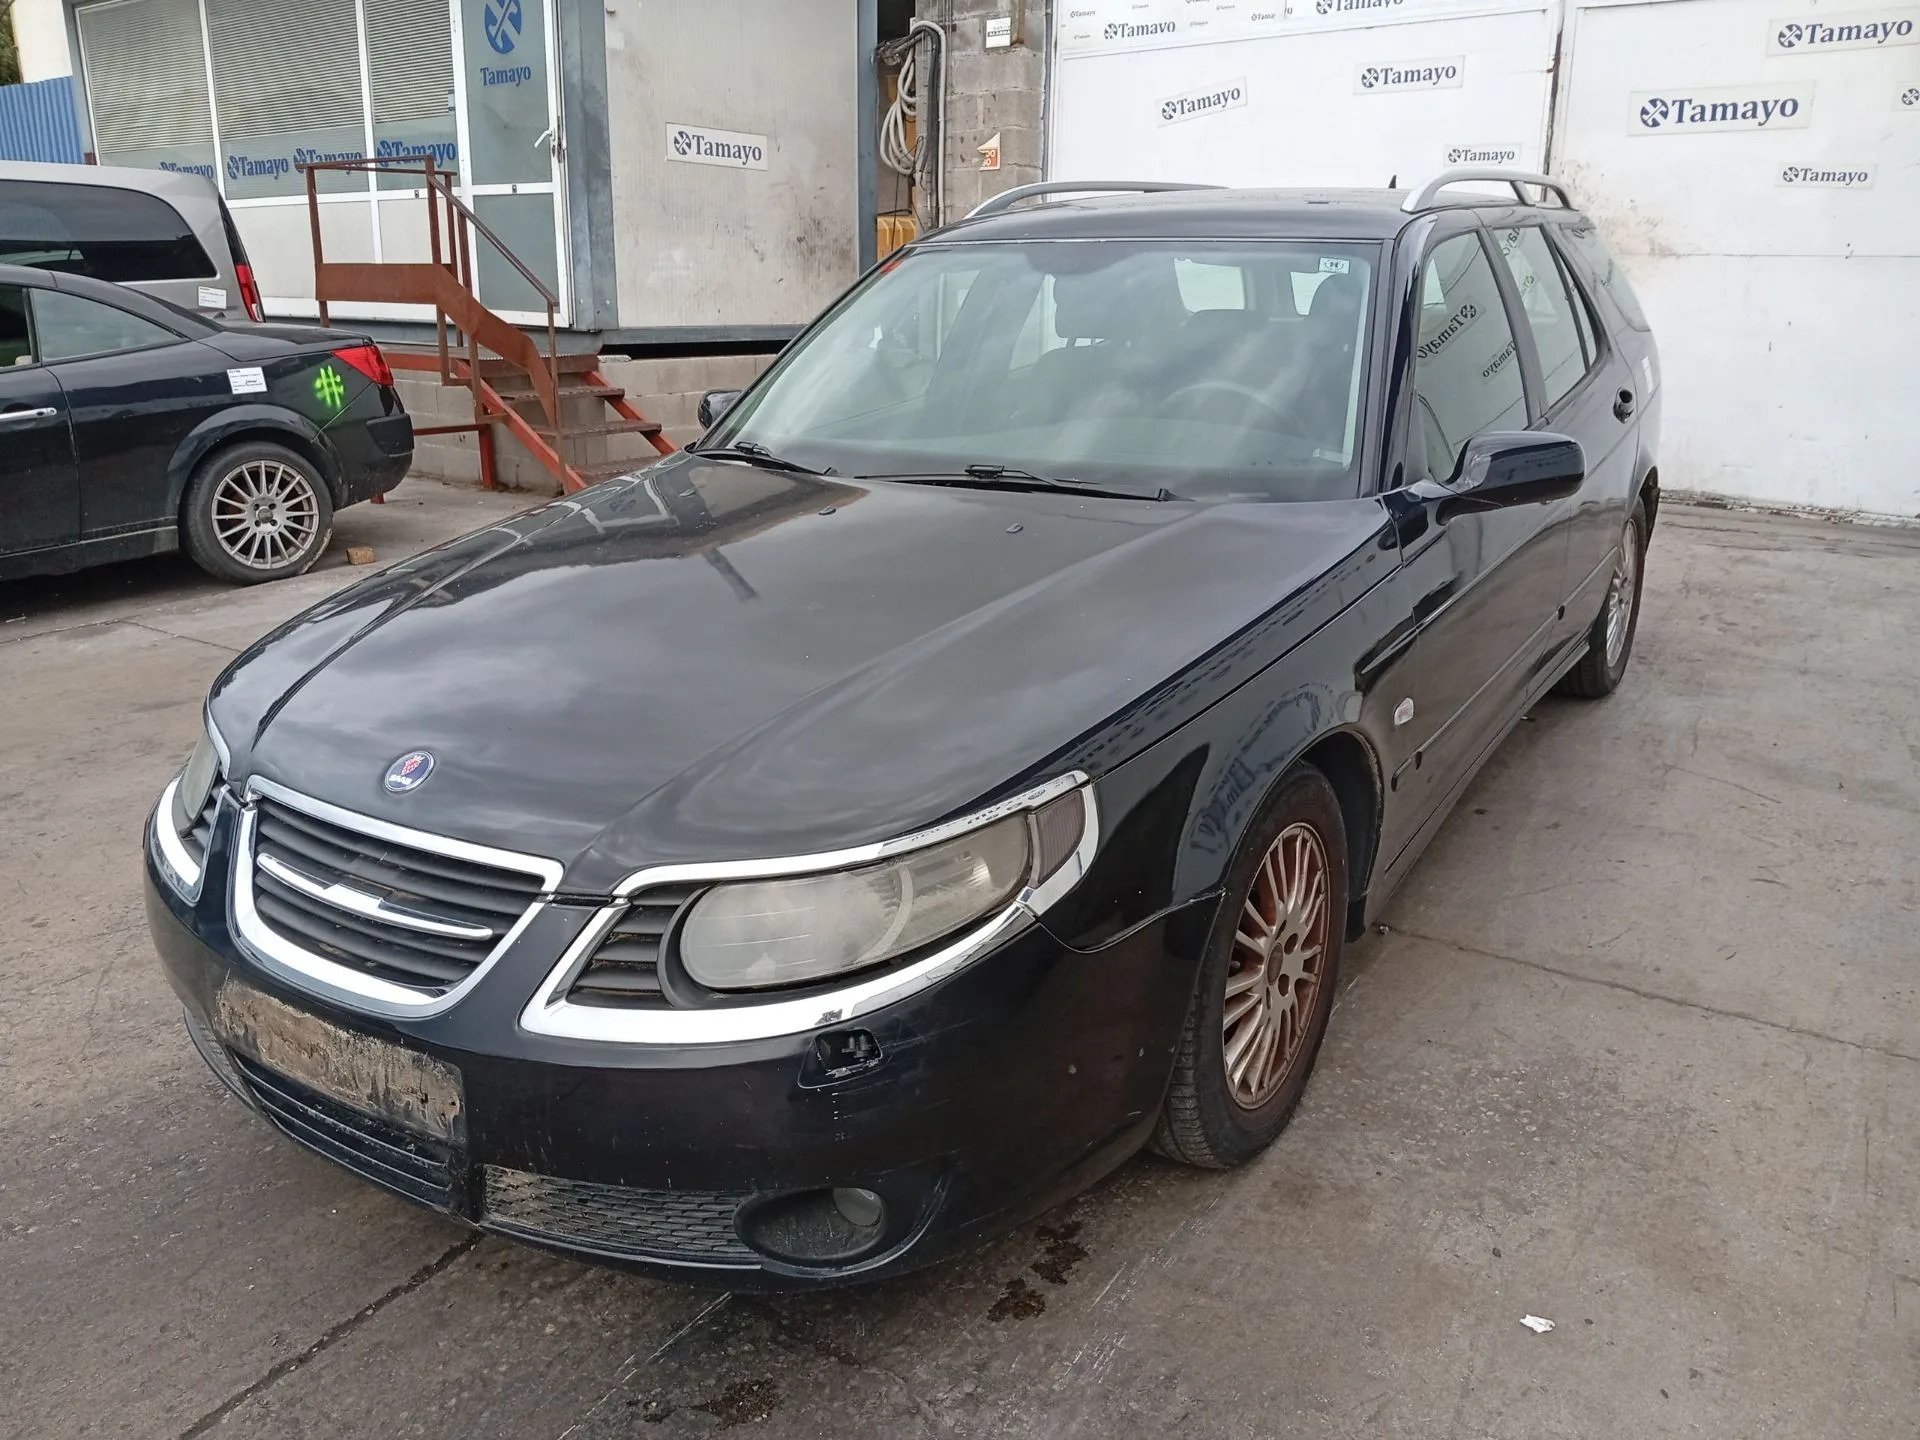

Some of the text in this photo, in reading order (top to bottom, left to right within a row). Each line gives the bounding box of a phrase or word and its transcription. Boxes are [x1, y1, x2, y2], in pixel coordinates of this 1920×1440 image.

[1804, 19, 1913, 44] Tamayo
[480, 66, 532, 87] Tamayo
[1380, 65, 1457, 86] Tamayo
[1176, 85, 1241, 116] Tamayo
[1671, 97, 1799, 126] Tamayo
[391, 141, 456, 168] Tamayo
[692, 134, 762, 165] Tamayo
[1461, 149, 1515, 163] Tamayo
[238, 156, 289, 180] Tamayo
[1800, 167, 1868, 186] Tamayo
